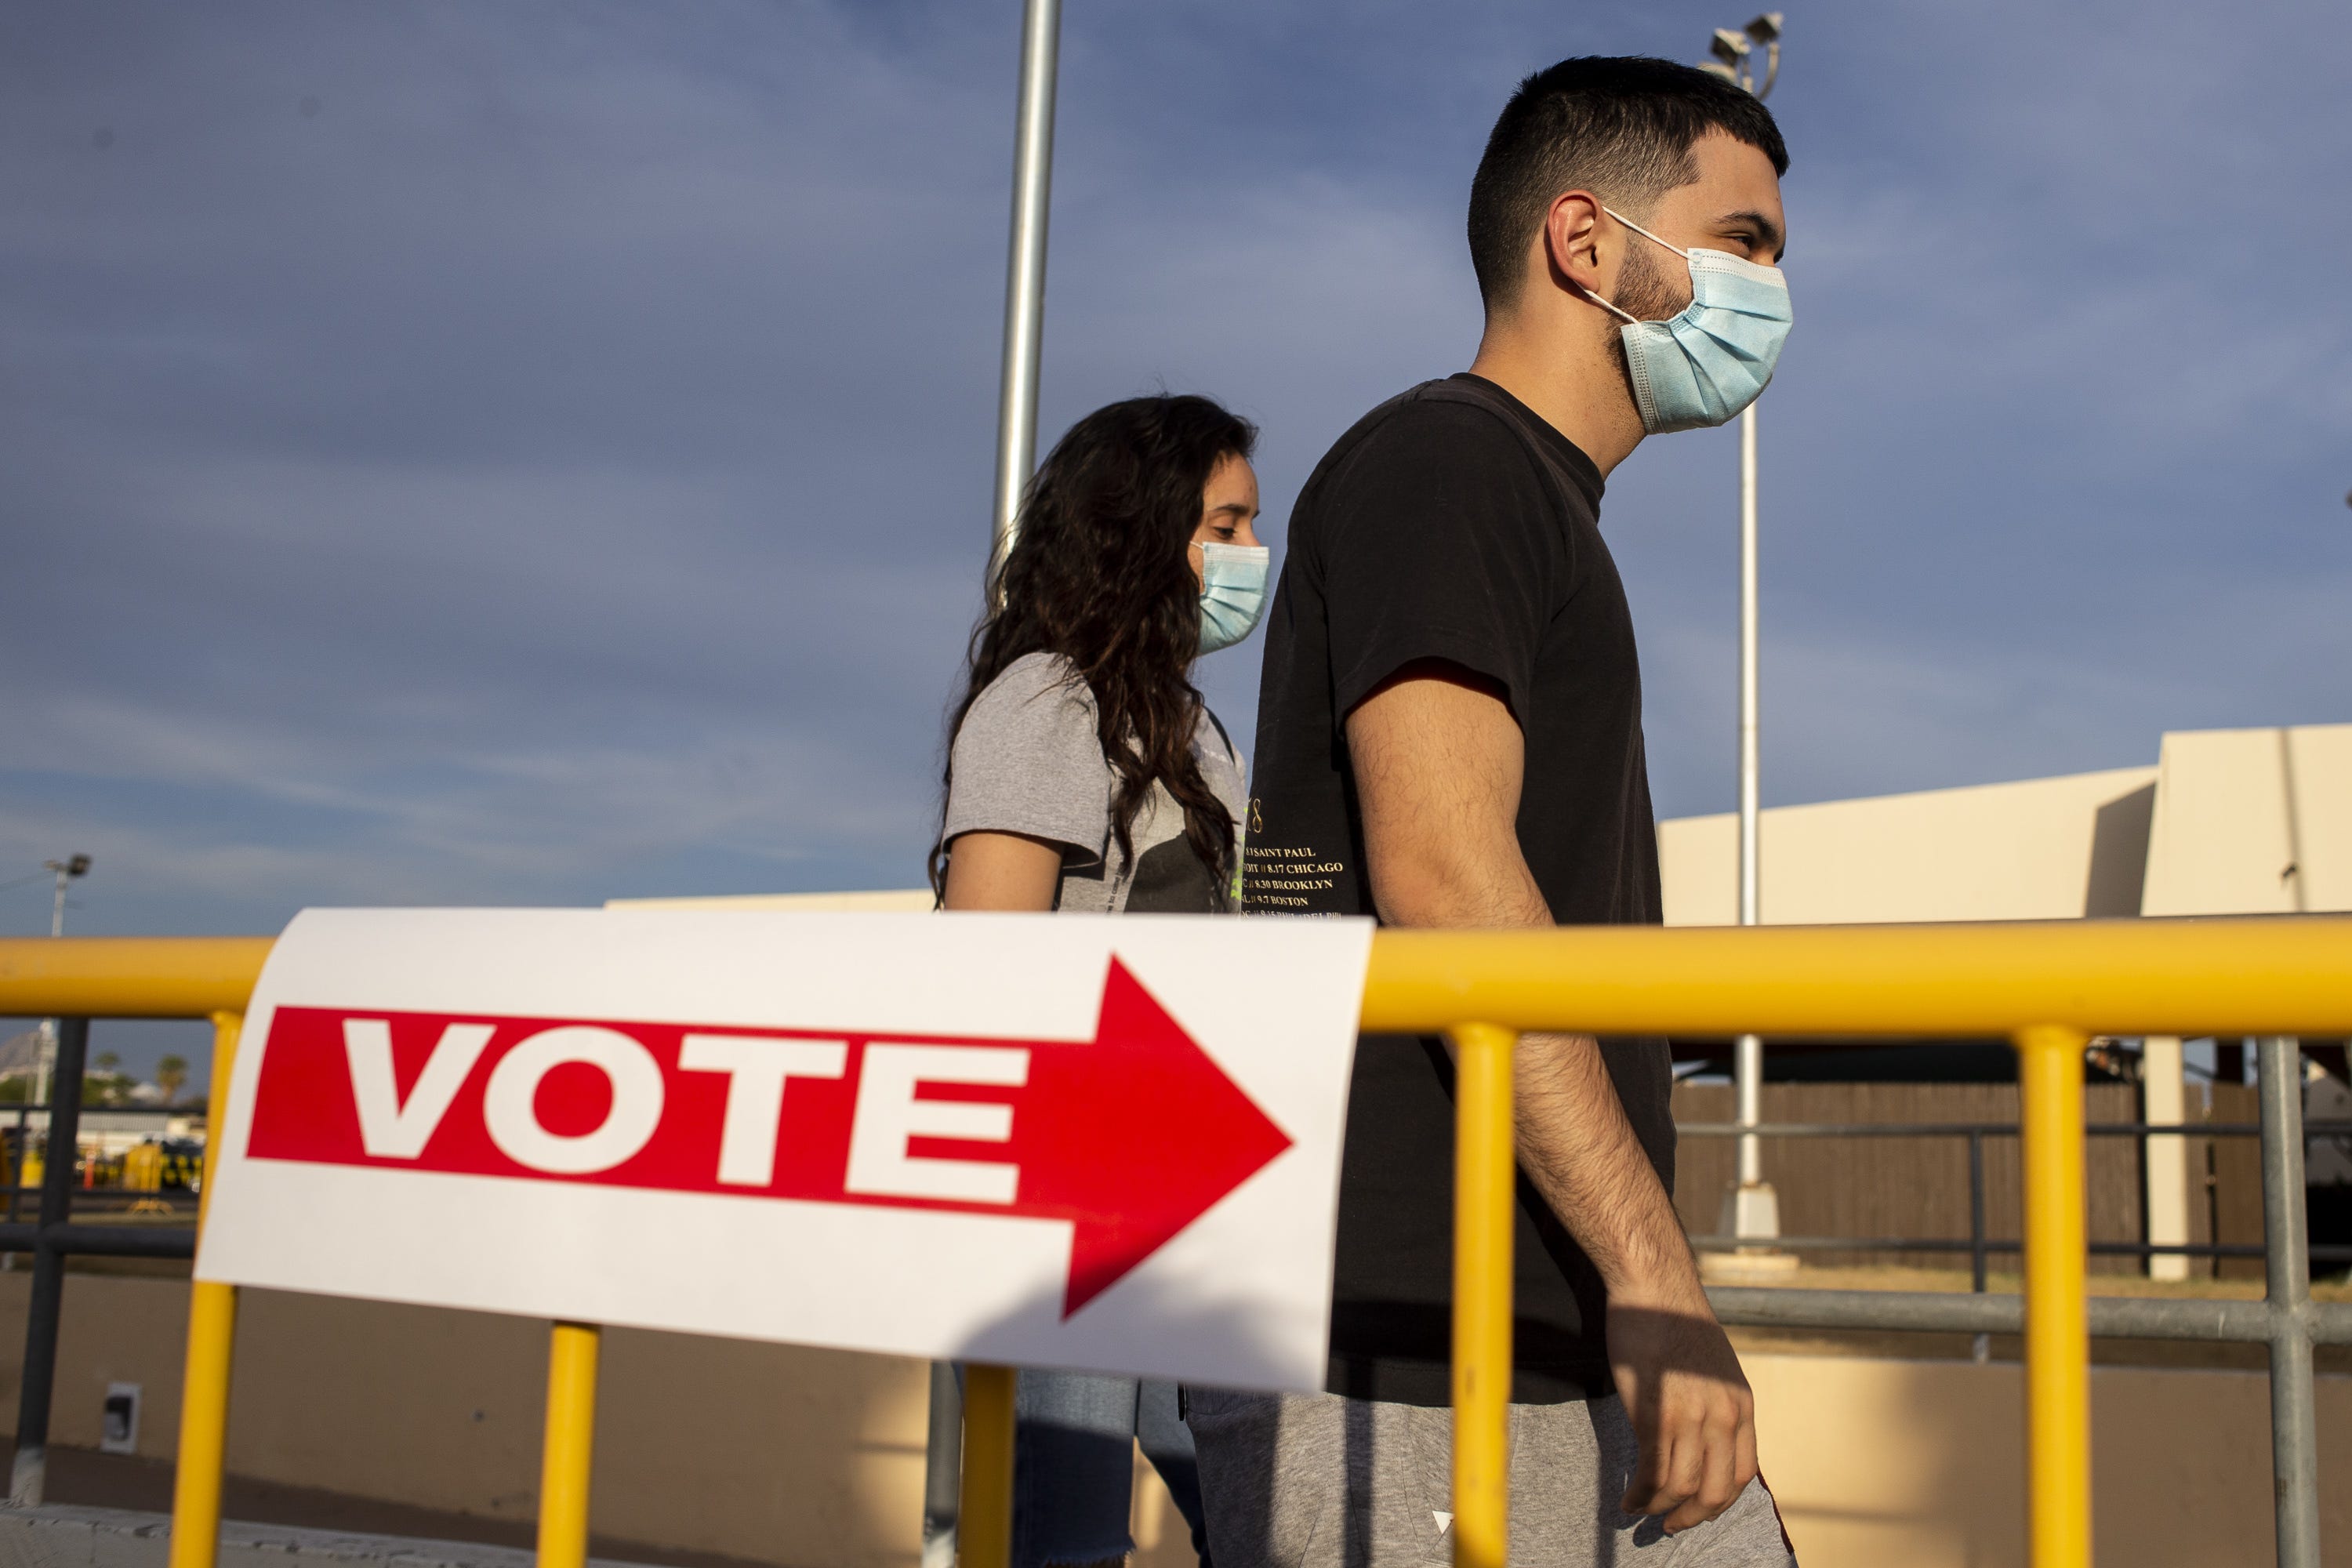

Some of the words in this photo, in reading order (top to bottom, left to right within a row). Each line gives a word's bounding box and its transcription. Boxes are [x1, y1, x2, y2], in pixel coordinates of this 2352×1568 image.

[1254, 848, 1282, 857] SAINT
[1284, 848, 1316, 858] PAUL
[1267, 864, 1284, 873] 8.17
[1286, 862, 1343, 874] CHICAGO
[1272, 879, 1334, 890] BROOKLYN
[1257, 895, 1269, 904] 9.7
[1270, 896, 1308, 906] BOSTON
[342, 1017, 1031, 1204] VOTE
